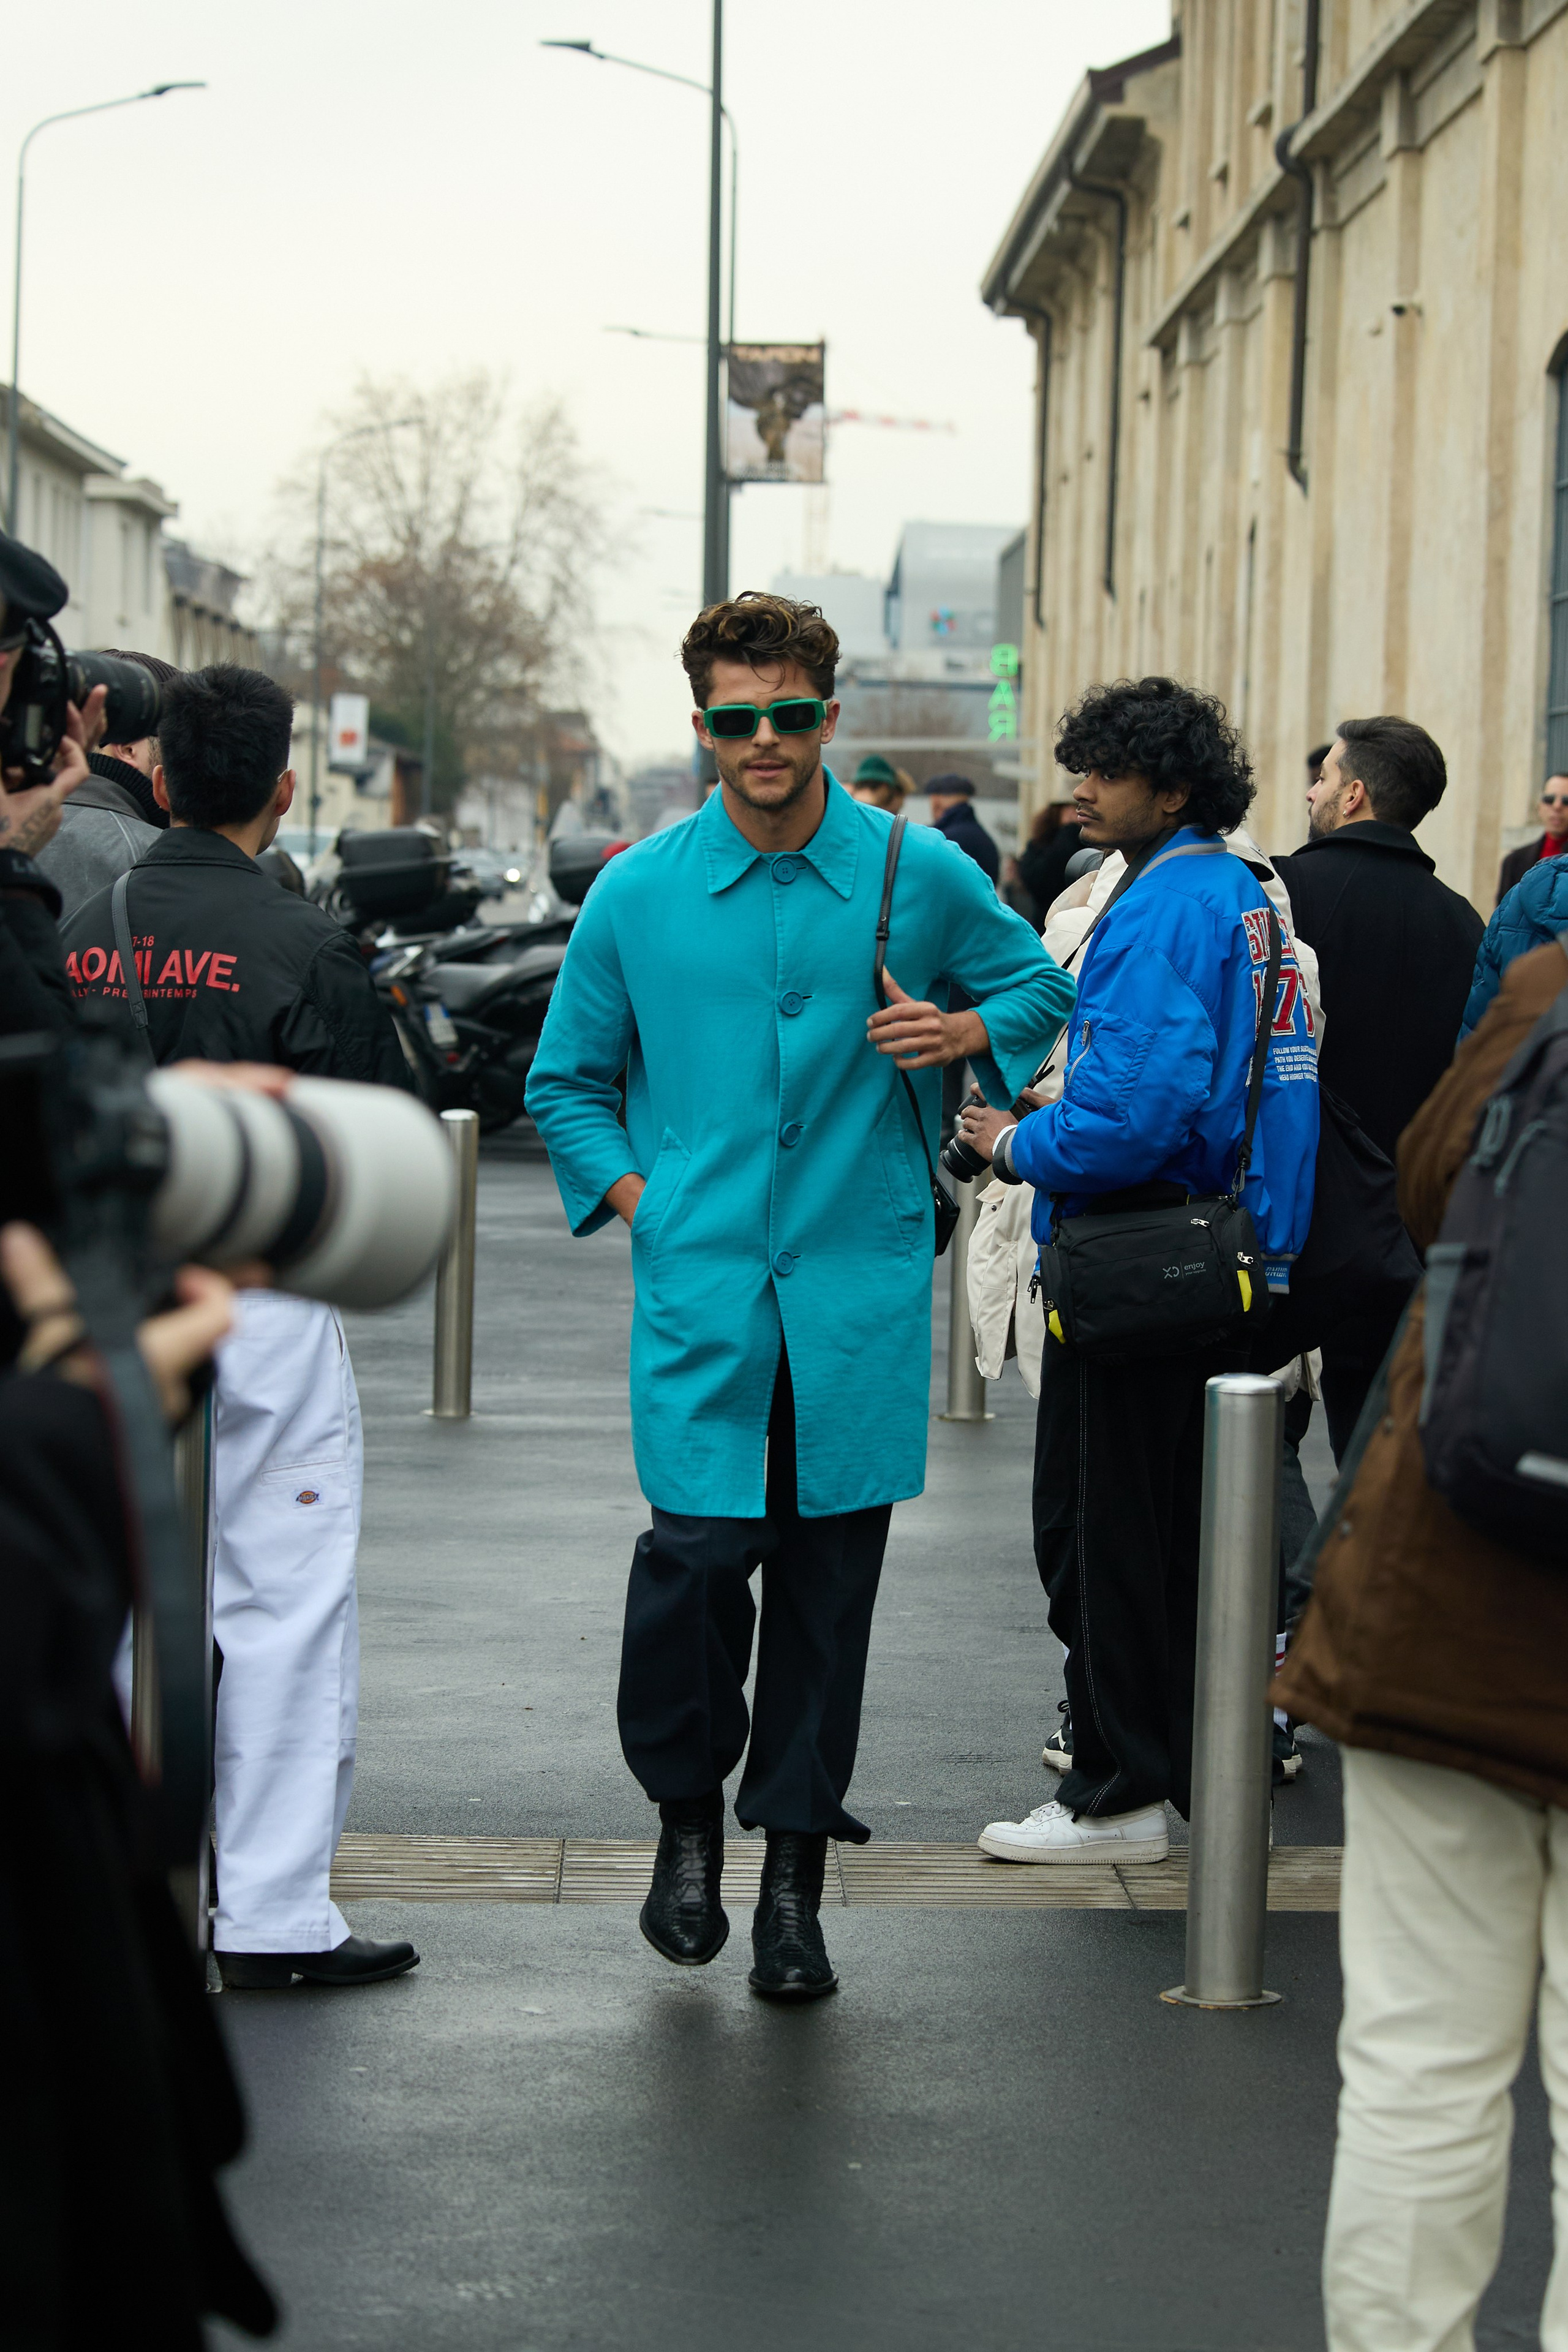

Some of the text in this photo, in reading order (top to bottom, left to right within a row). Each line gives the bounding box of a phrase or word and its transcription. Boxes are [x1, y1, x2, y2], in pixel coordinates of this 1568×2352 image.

[157, 950, 240, 992] AVE.
[143, 988, 197, 998] RINTEMPS
[1184, 1262, 1205, 1270] enjoy
